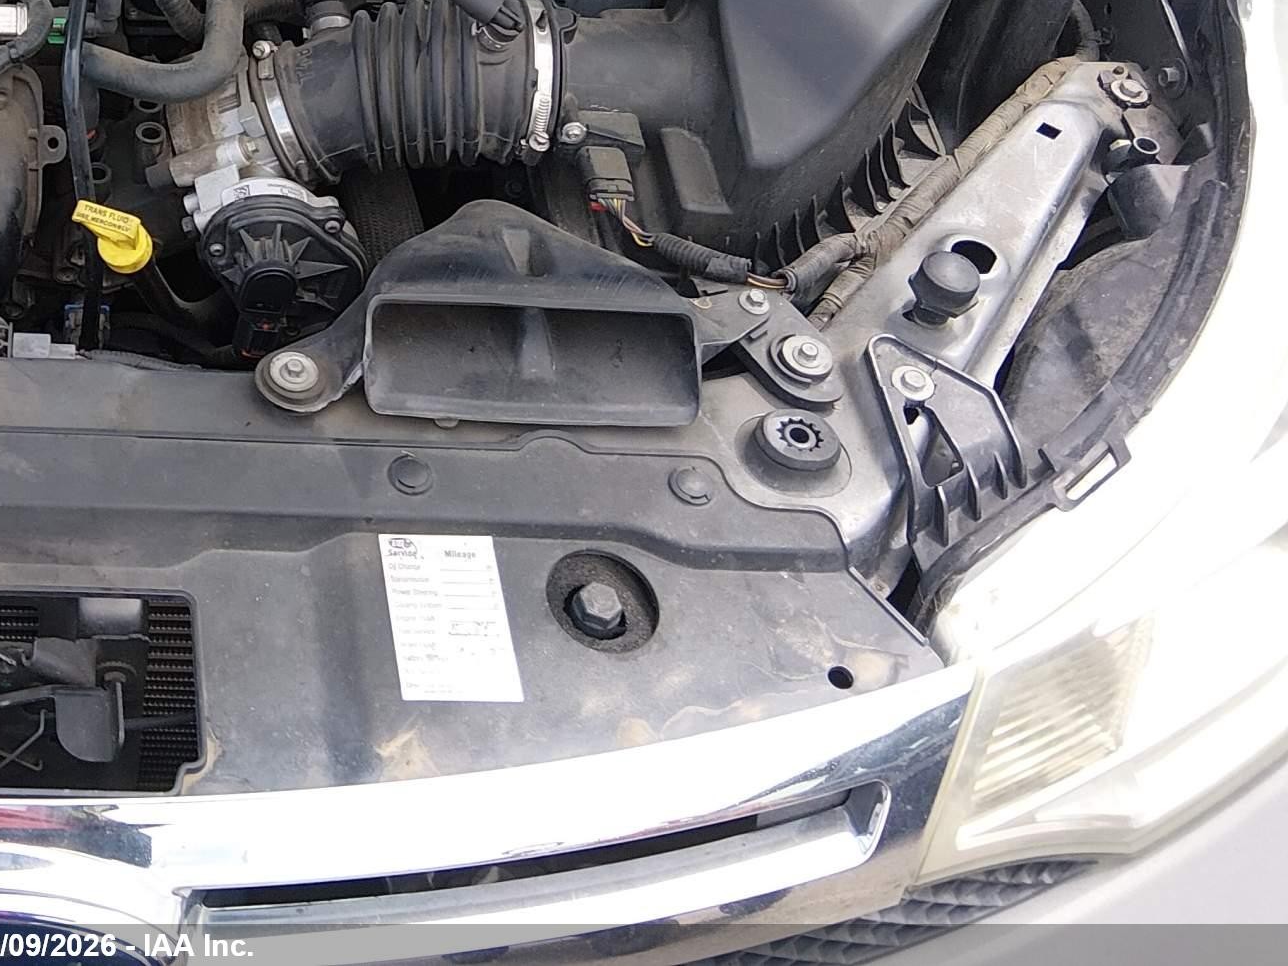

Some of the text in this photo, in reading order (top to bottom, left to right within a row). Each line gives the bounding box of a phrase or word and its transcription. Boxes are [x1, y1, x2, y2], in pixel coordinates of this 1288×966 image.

[84, 204, 129, 224] TRANS FLUID
[444, 550, 476, 560] Mileage
